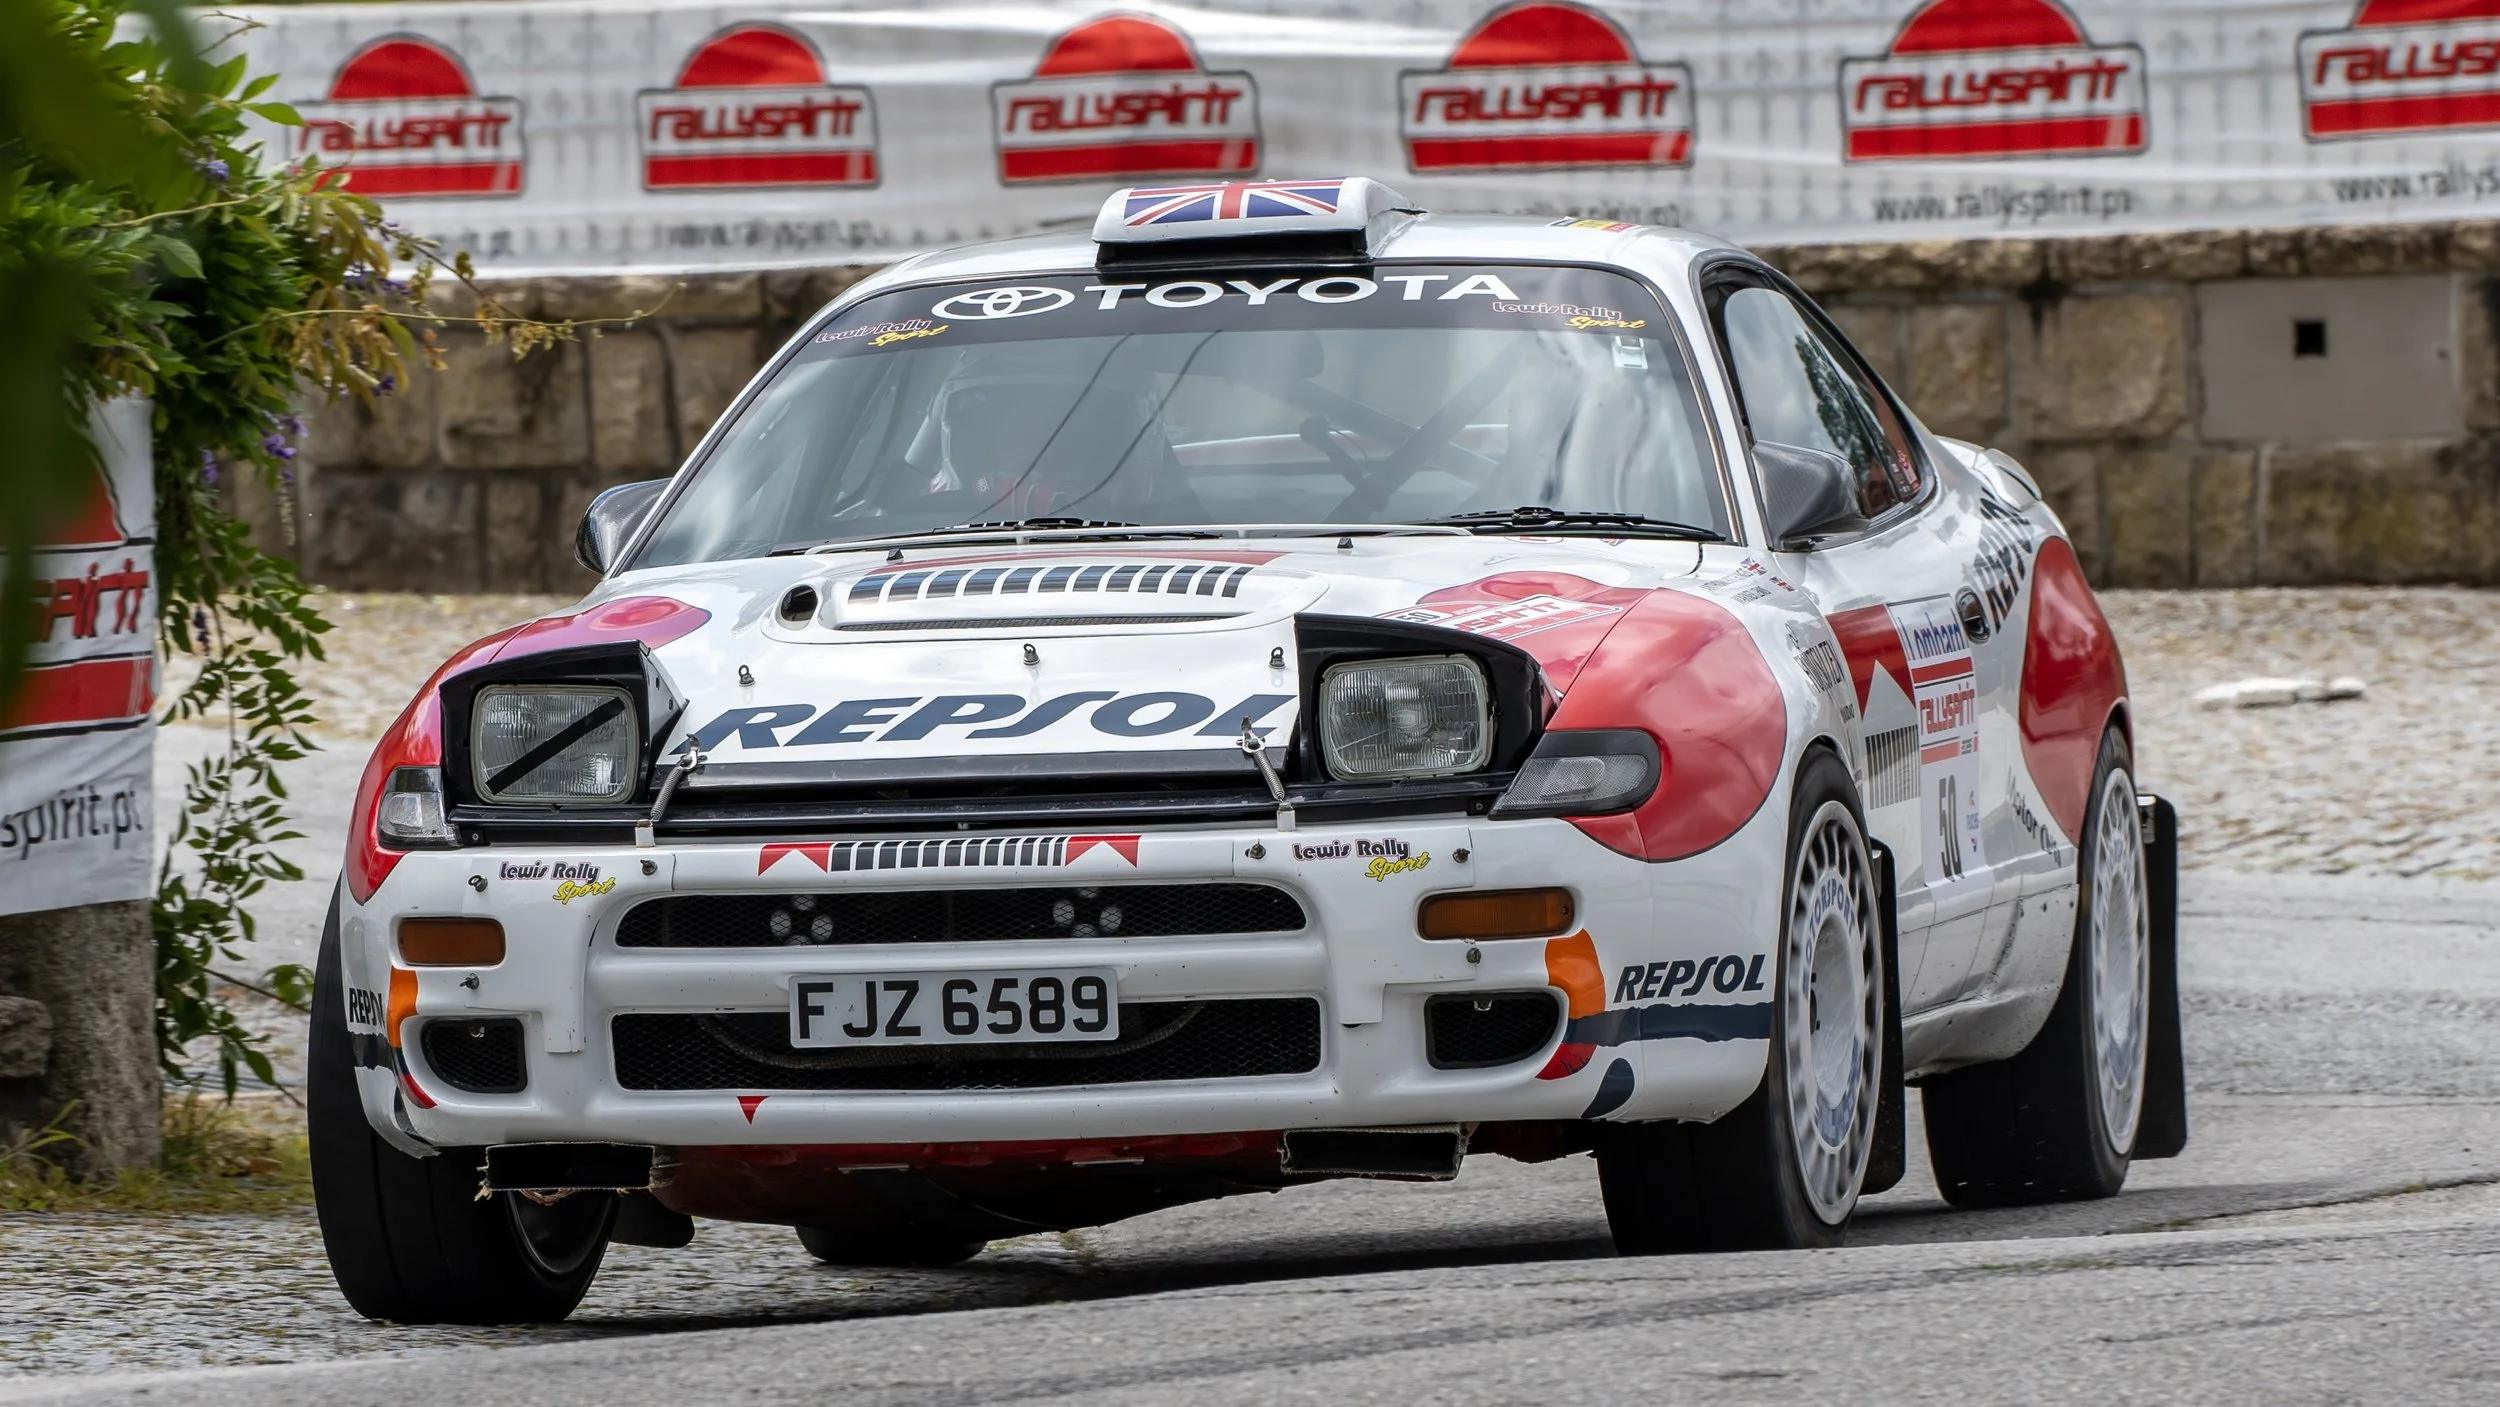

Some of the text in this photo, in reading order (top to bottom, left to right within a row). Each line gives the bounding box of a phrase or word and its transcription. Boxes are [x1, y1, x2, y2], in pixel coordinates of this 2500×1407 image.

[2314, 38, 2500, 87] rallys
[1084, 273, 1521, 310] TOYOTA
[1492, 300, 1623, 321] Lewis Rally
[1564, 315, 1646, 330] Sport
[815, 318, 932, 344] Lewis Rally
[867, 325, 948, 347] Sport
[669, 691, 1298, 755] REPSOL
[1938, 773, 1965, 883] 50
[1292, 837, 1410, 862] Lewis Rally
[500, 860, 600, 884] Lewis Rally
[1365, 851, 1431, 882] Sport
[553, 876, 617, 905] Sport
[1613, 953, 1767, 1004] REPSOL
[797, 975, 1109, 1040] FJZ 6589
